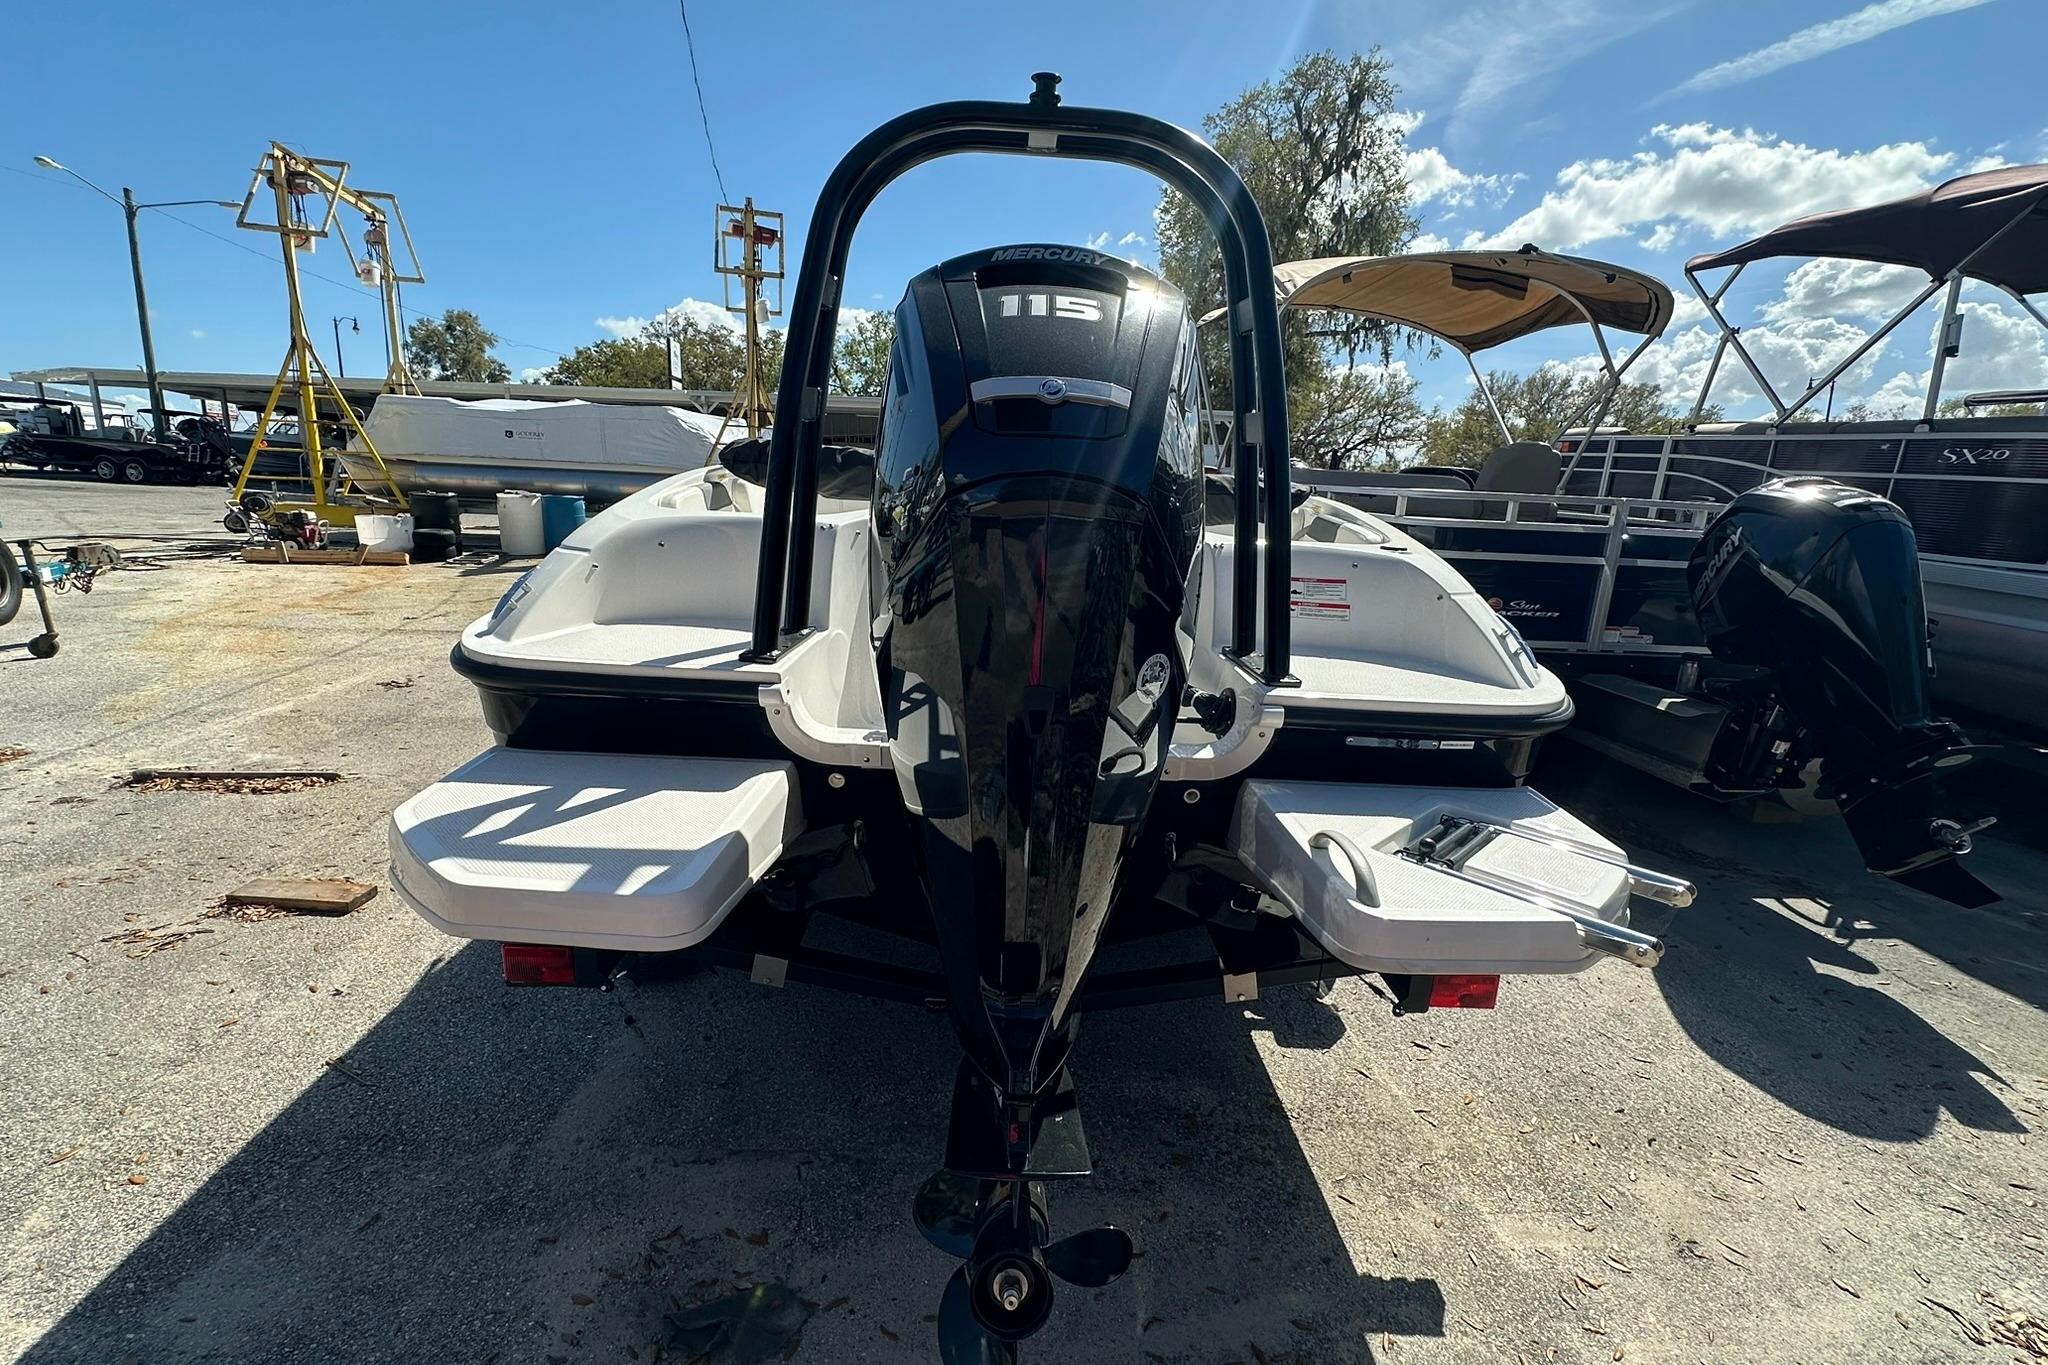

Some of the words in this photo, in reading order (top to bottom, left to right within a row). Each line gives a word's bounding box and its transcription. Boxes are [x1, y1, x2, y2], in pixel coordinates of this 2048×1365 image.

[991, 247, 1110, 265] MERCURY
[999, 294, 1103, 321] 115
[1937, 448, 2011, 465] SX20
[1505, 600, 1542, 610] Sun
